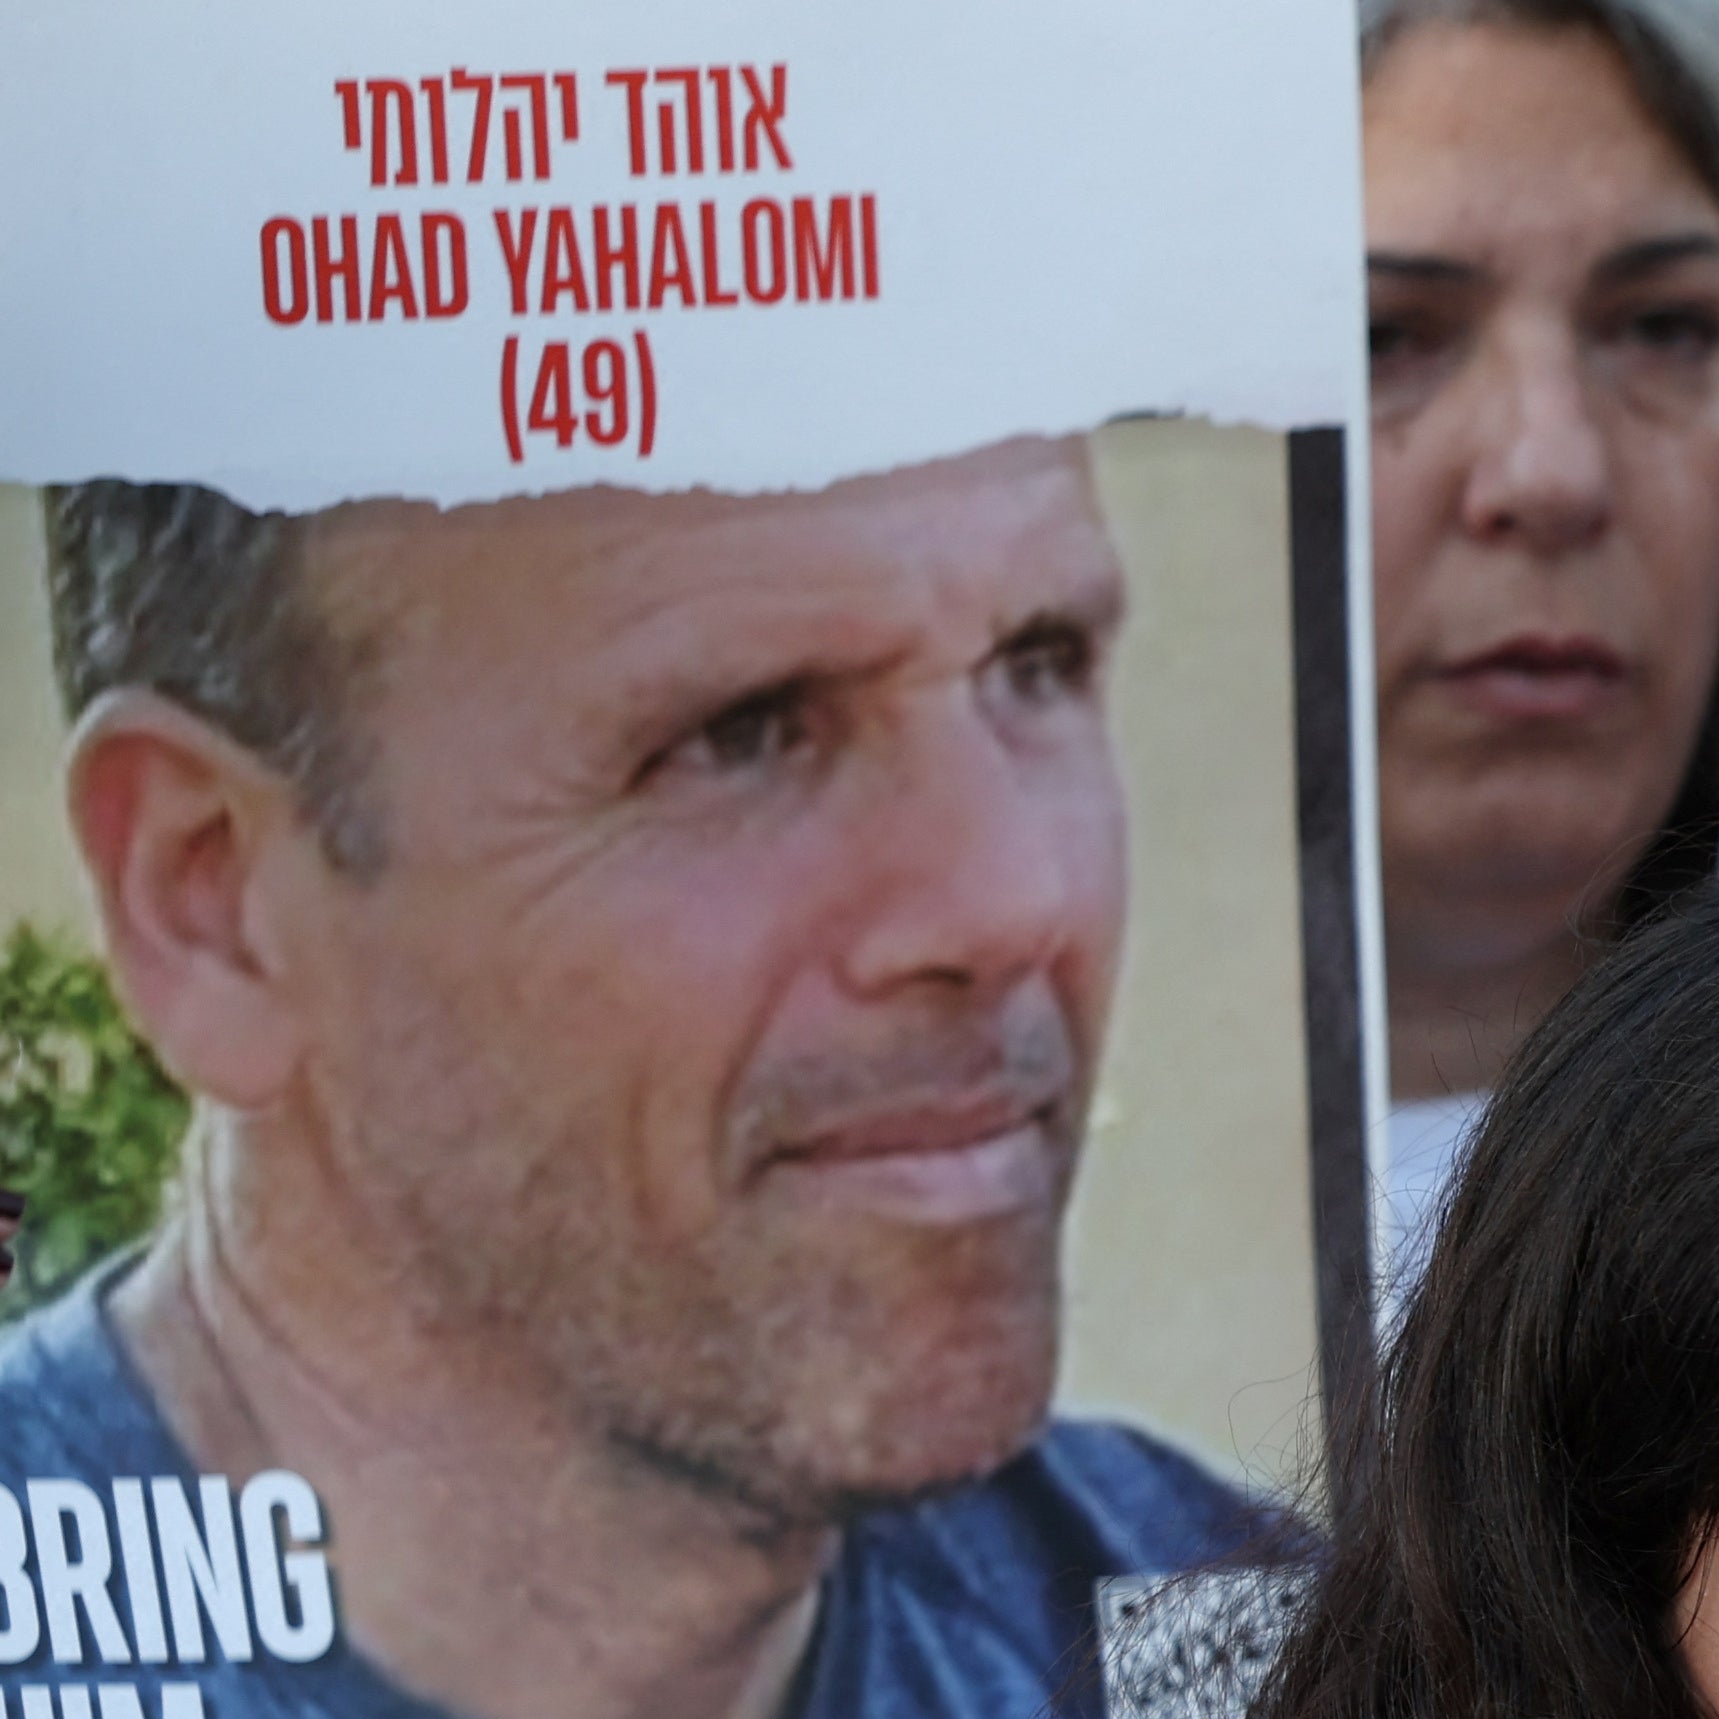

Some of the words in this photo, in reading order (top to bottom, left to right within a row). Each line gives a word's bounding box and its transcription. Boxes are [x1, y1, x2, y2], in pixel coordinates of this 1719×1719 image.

[335, 66, 579, 187] יהלומי
[605, 65, 793, 178] אוהד
[260, 211, 470, 326] OHAD
[494, 194, 880, 315] YAHALOMI
[502, 330, 657, 463] (49)
